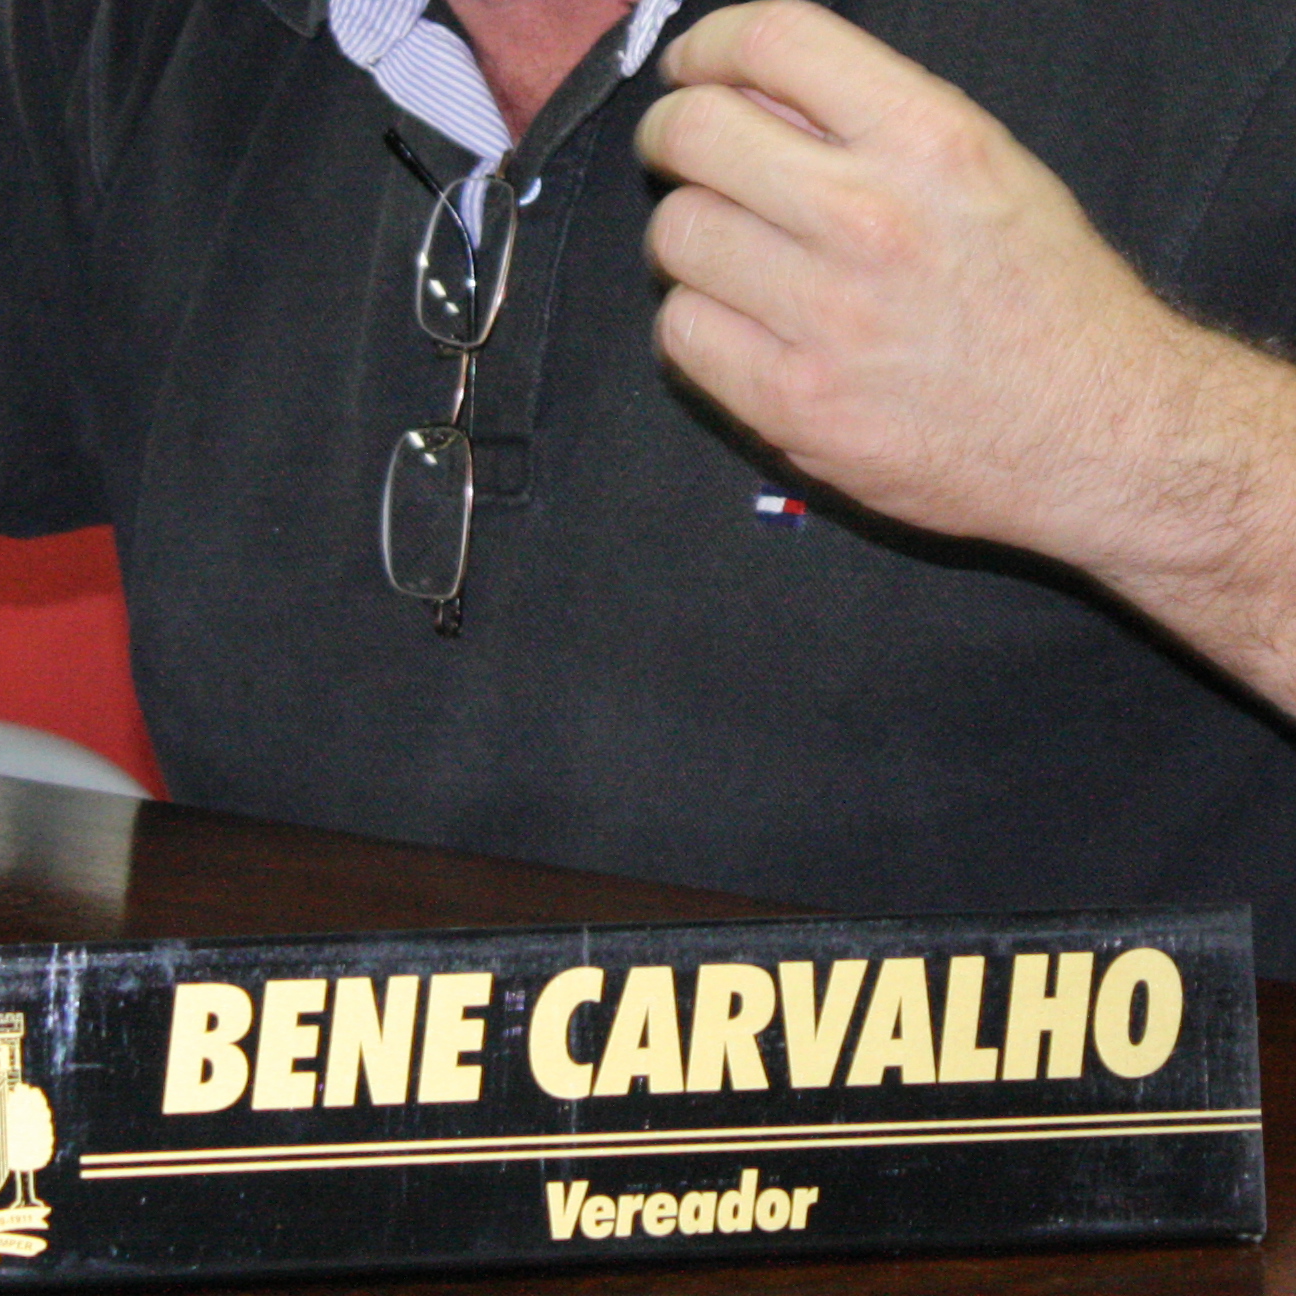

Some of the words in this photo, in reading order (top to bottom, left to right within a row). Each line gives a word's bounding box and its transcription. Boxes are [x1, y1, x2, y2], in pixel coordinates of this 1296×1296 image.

[162, 971, 493, 1115] BENE
[528, 947, 1184, 1101] CARVALHO
[545, 1167, 819, 1241] Vereador
